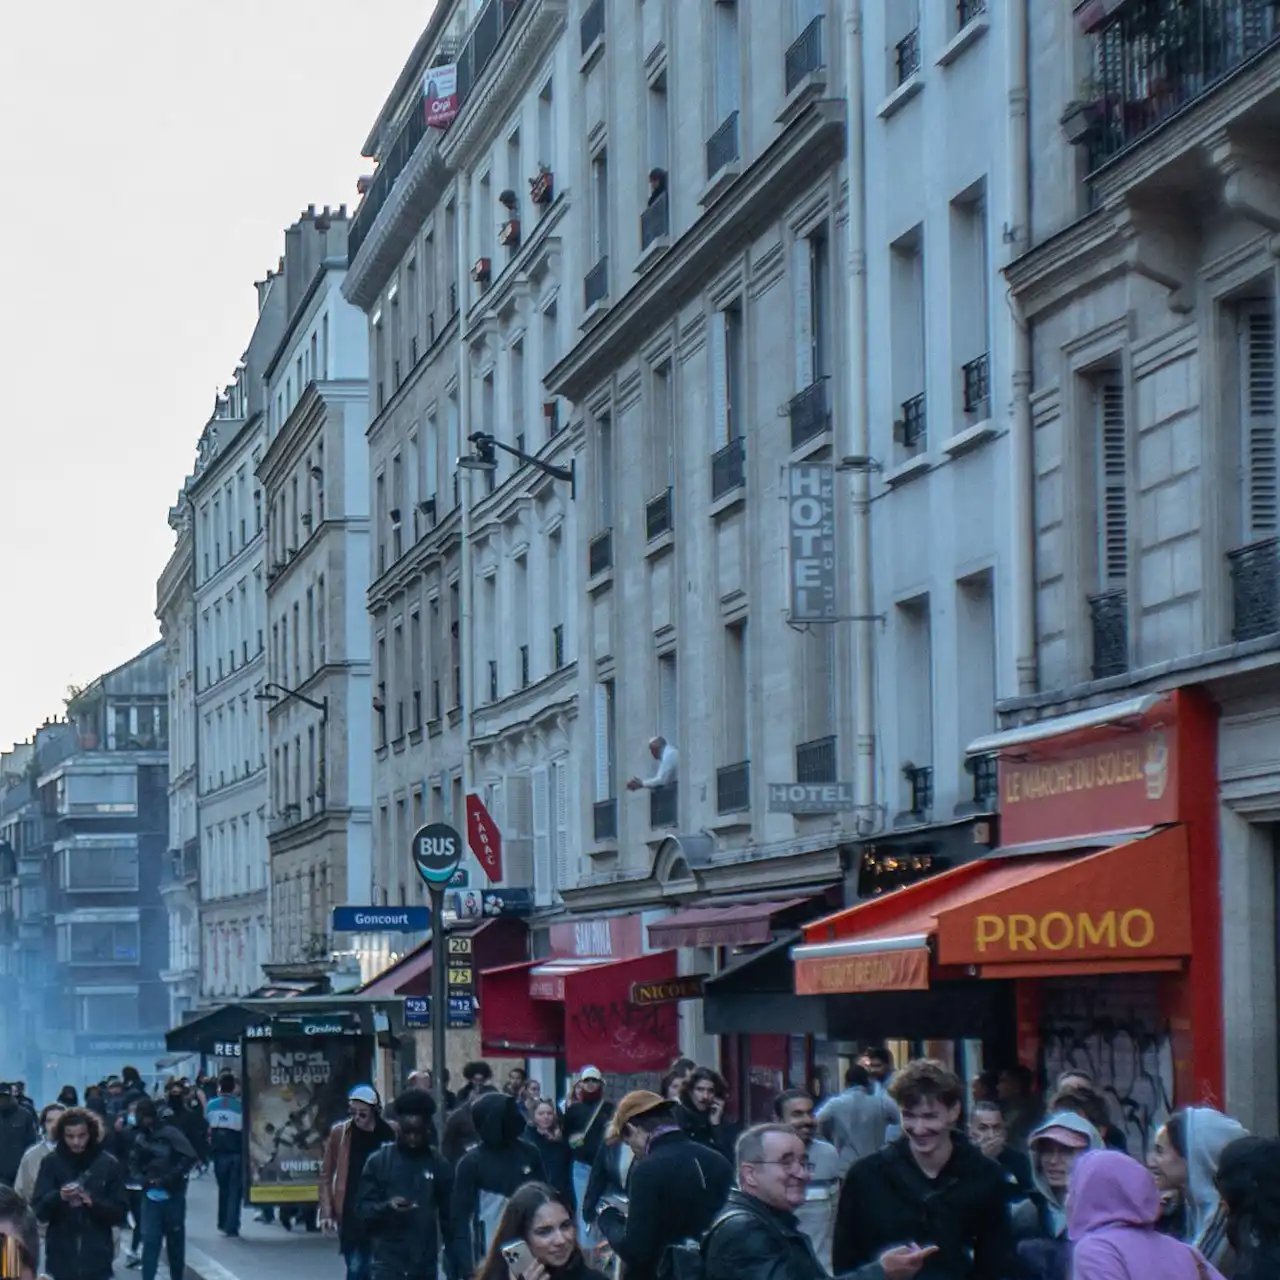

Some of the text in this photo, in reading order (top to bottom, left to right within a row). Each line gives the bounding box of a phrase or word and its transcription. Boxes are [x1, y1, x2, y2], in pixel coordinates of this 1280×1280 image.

[792, 467, 822, 618] HOTEL
[1006, 772, 1020, 803] LE
[1075, 757, 1095, 790] DU
[1097, 750, 1144, 787] SOLEIL
[771, 786, 852, 801] HOTEL
[473, 811, 495, 865] TABAC
[421, 838, 455, 855] BUS
[355, 913, 409, 925] Goncourt
[977, 909, 1154, 952] PROMO
[452, 939, 469, 952] 20
[452, 970, 469, 982] 75
[305, 1024, 342, 1035] Casino
[271, 1074, 329, 1084] DU FOOT
